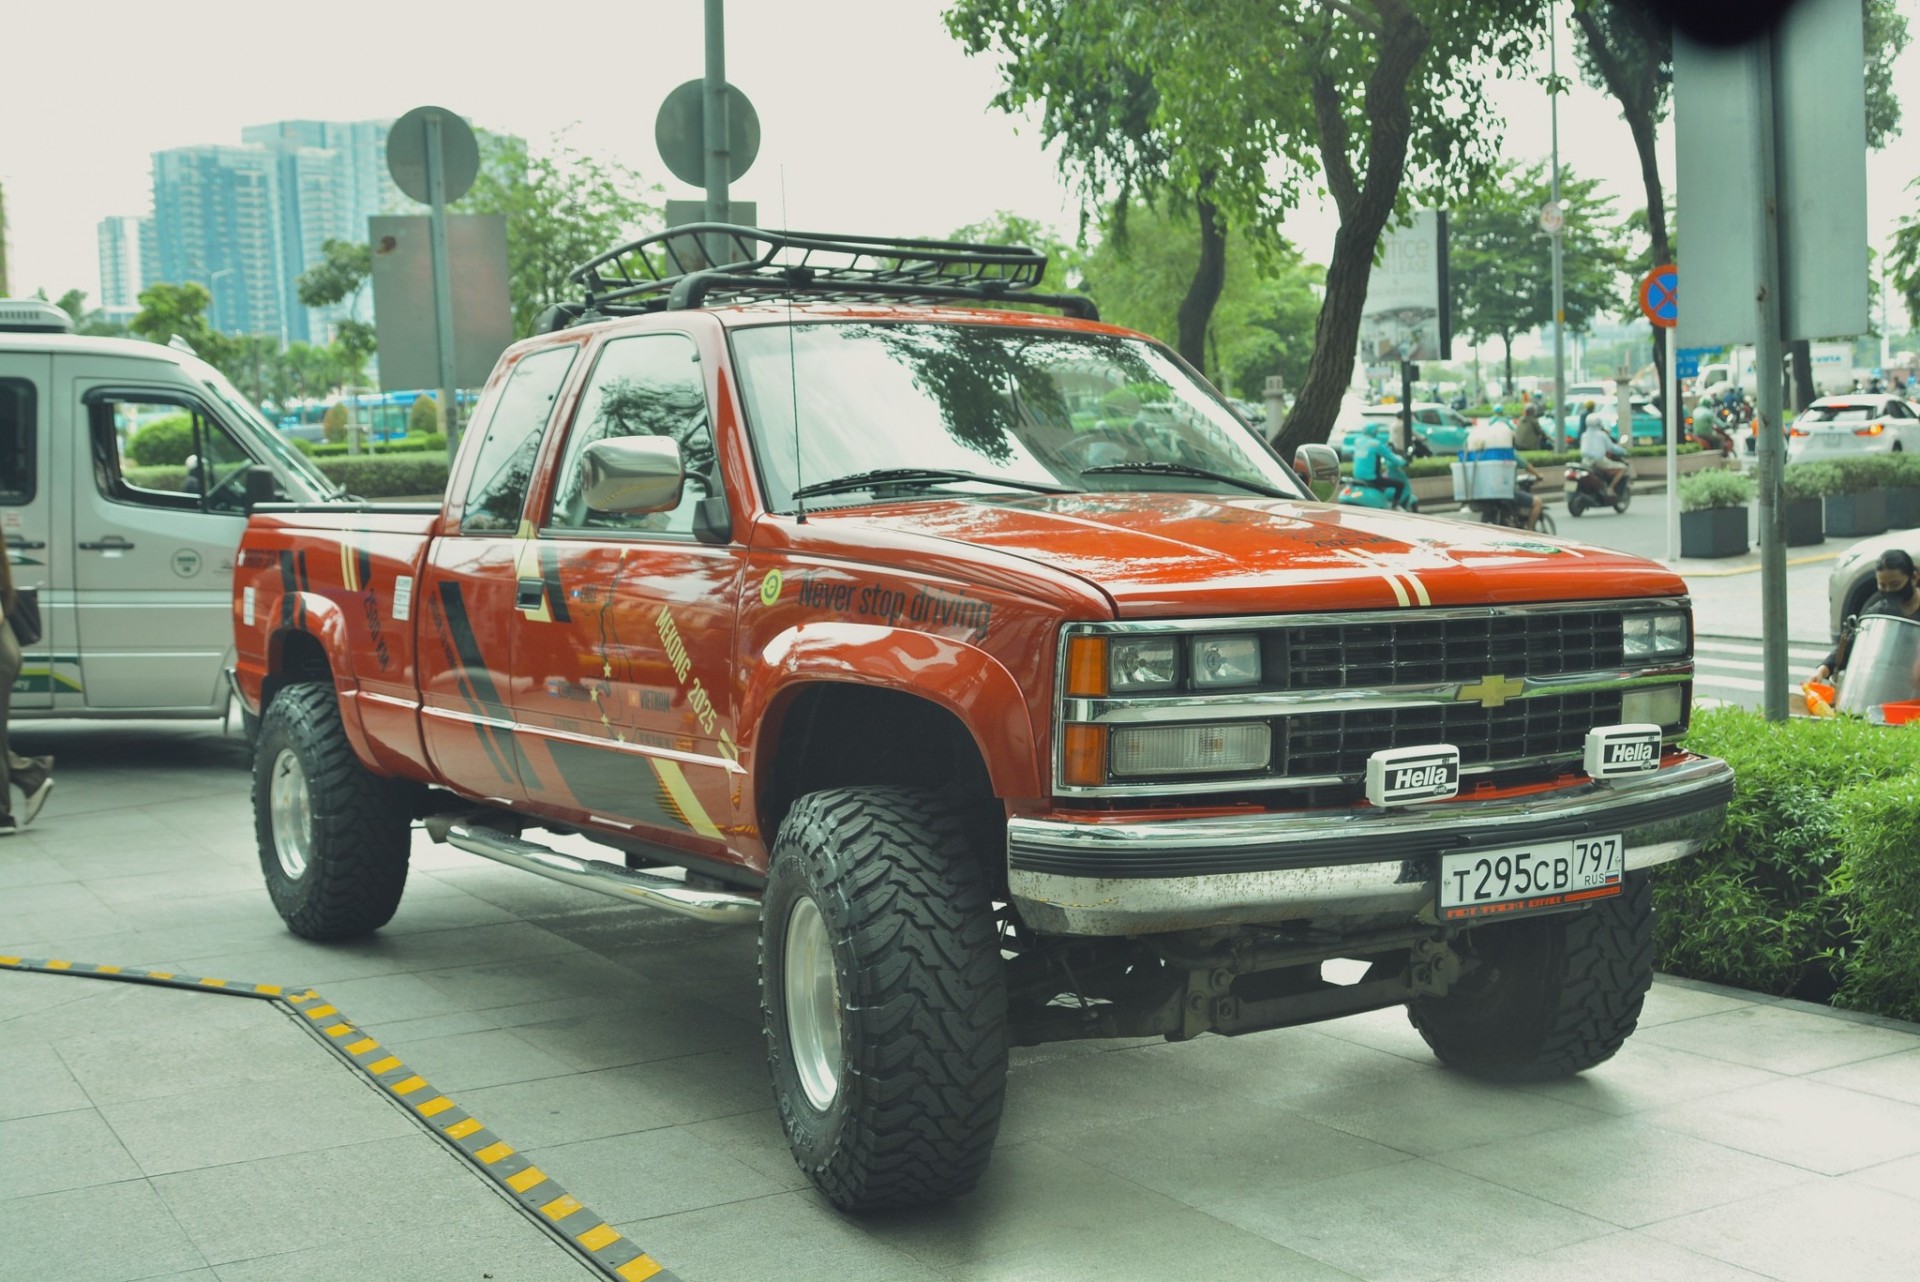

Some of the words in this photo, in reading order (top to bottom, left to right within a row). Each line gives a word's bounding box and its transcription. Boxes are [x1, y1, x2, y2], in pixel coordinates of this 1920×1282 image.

[797, 572, 854, 612] Never
[860, 582, 906, 627] stop
[911, 588, 993, 640] driving
[655, 605, 691, 685] MEKONG
[687, 677, 717, 735] 2025
[1611, 742, 1653, 763] Hella
[1394, 766, 1448, 790] Hella
[1576, 840, 1616, 875] 797
[1585, 872, 1604, 886] RUS
